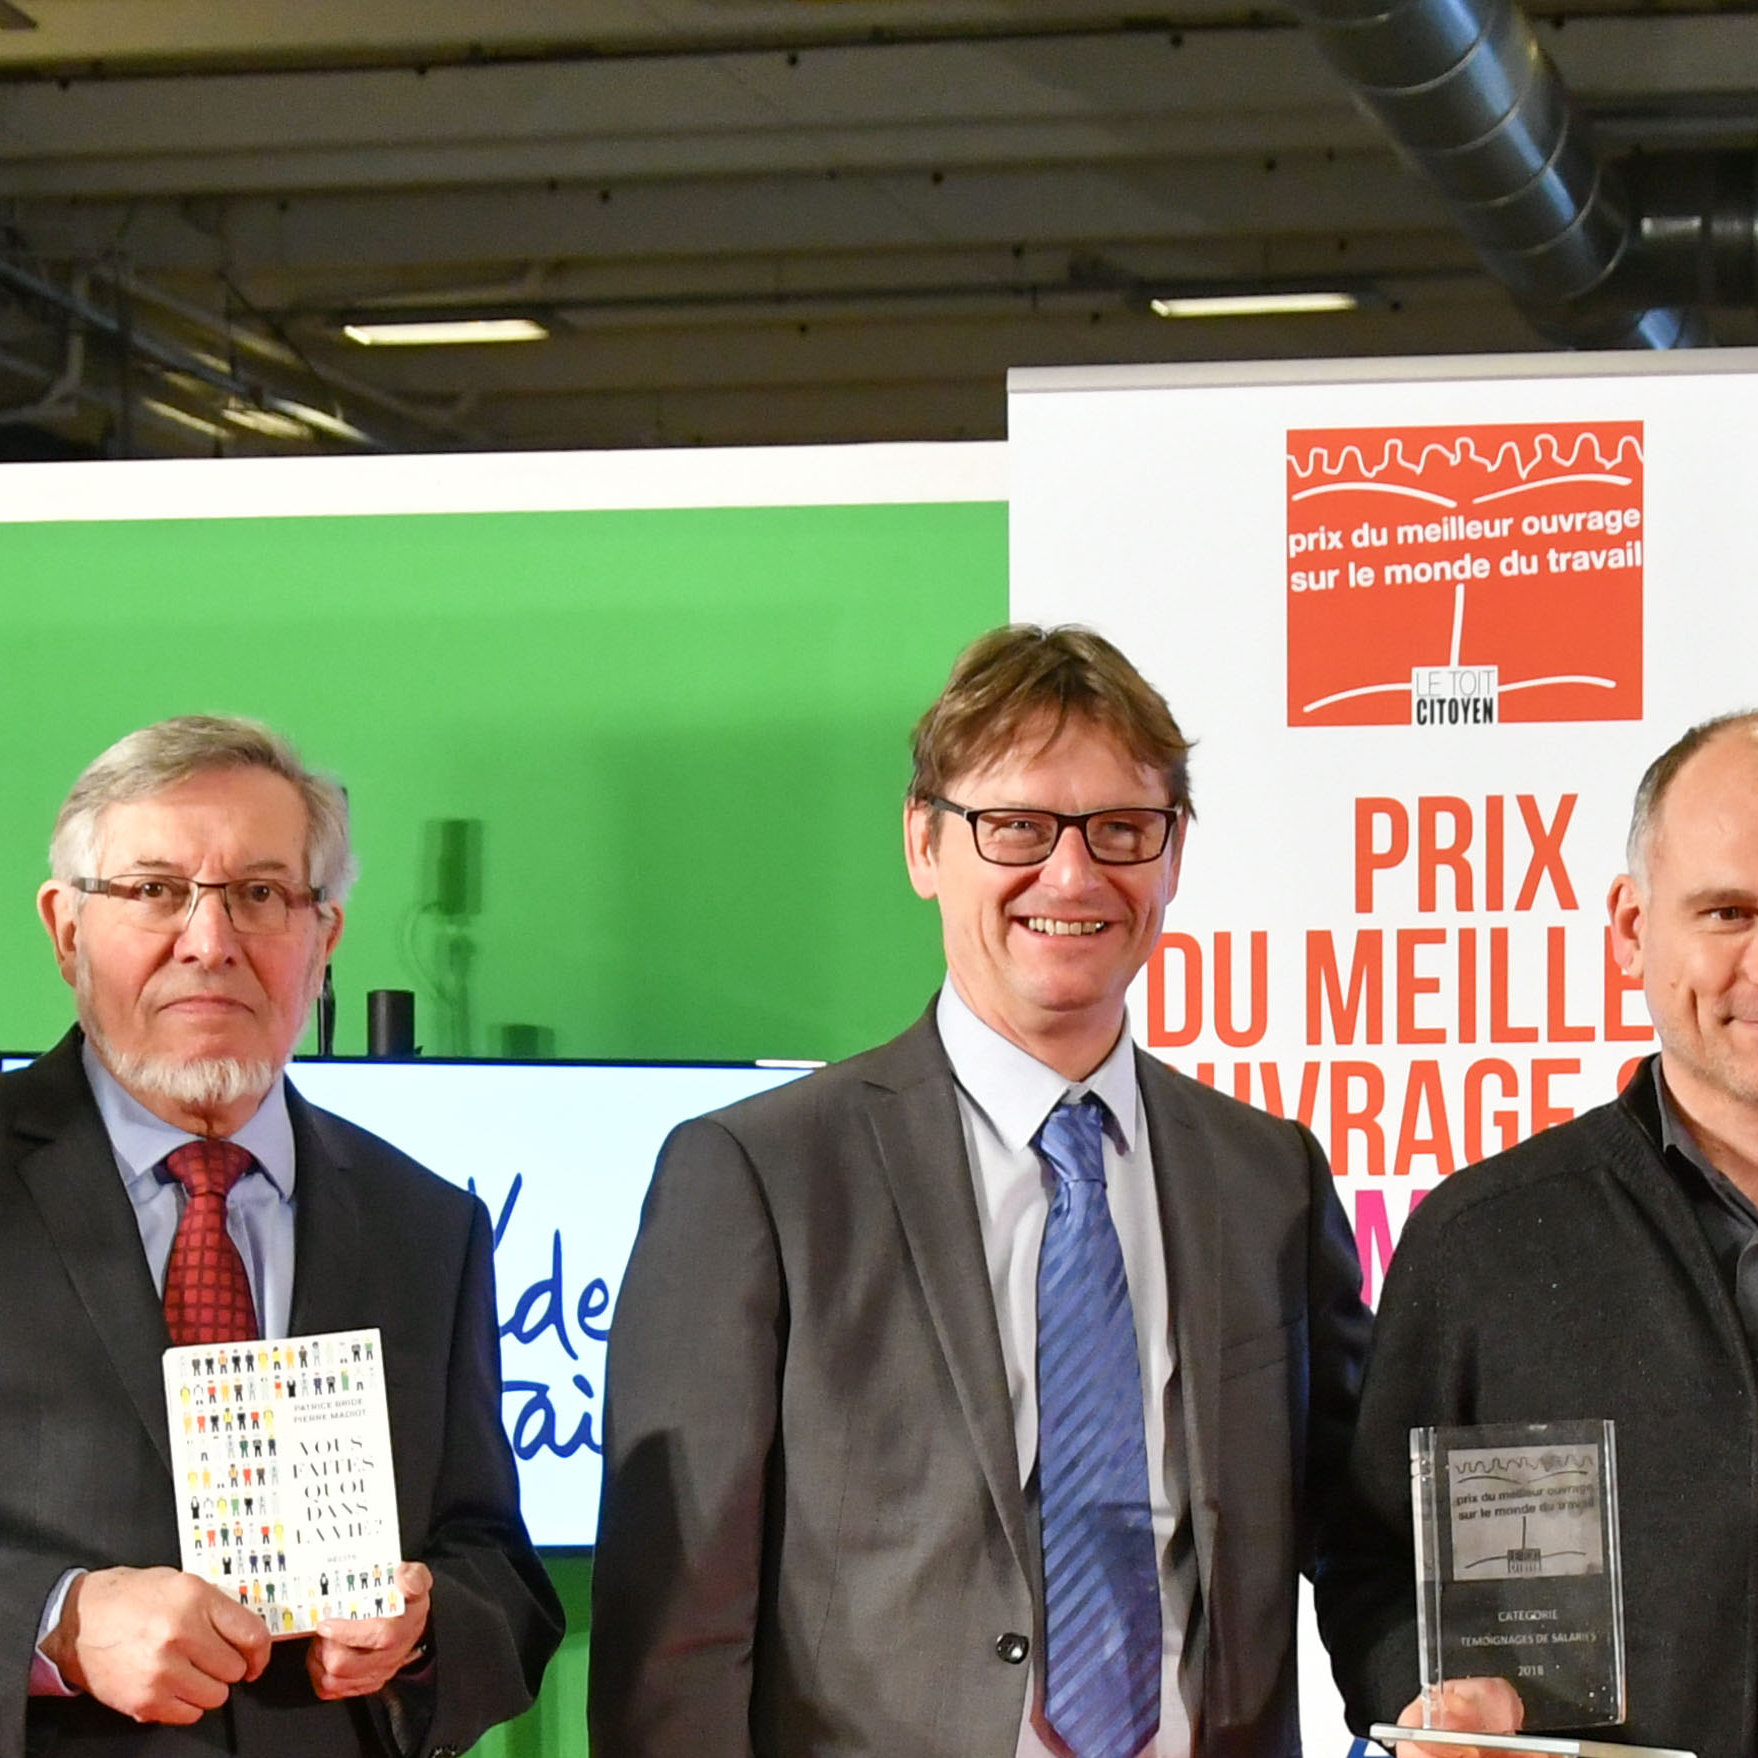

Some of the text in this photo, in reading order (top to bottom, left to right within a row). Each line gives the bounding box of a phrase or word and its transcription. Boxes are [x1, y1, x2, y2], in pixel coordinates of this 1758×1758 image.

[1288, 507, 1641, 558] prix du meilleur ouvrage
[1290, 540, 1643, 592] sur le monde du travail
[1416, 670, 1496, 697] LE TOIT
[1416, 698, 1494, 725] CITOYEN
[1354, 792, 1580, 915] PRIX
[1146, 929, 1269, 1050] DU
[1456, 1494, 1478, 1506] prix
[1481, 1491, 1496, 1502] du
[1498, 1488, 1544, 1500] meilleur
[1458, 1510, 1477, 1521] sur
[1480, 1508, 1491, 1518] le
[1494, 1503, 1536, 1516] monde
[1536, 1633, 1550, 1644] DE
